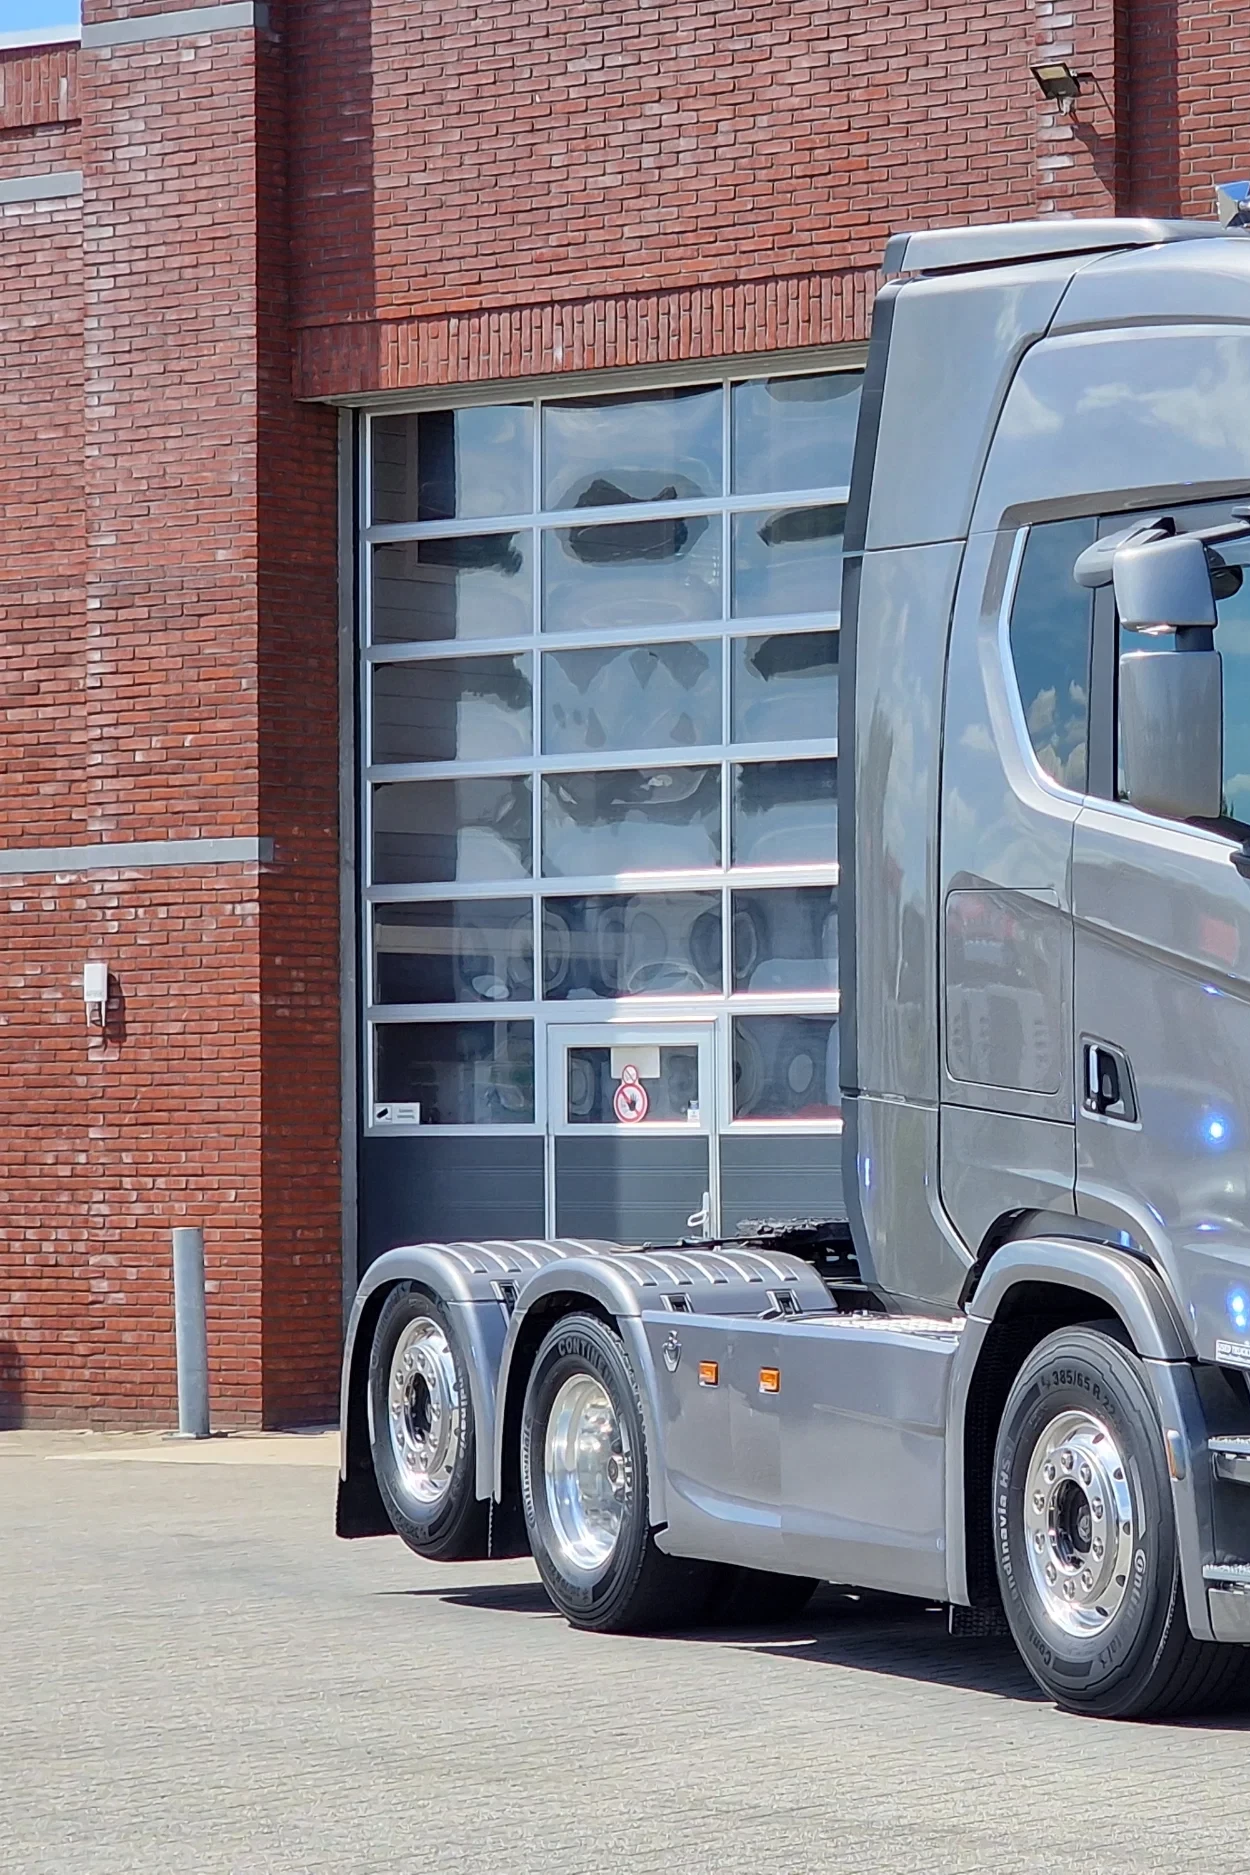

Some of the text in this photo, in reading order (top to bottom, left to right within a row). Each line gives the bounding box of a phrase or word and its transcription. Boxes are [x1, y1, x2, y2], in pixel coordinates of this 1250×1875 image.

[1052, 1369, 1091, 1392] 385/65
[1092, 1383, 1101, 1401] R
[1105, 1548, 1147, 1664] Contintal
